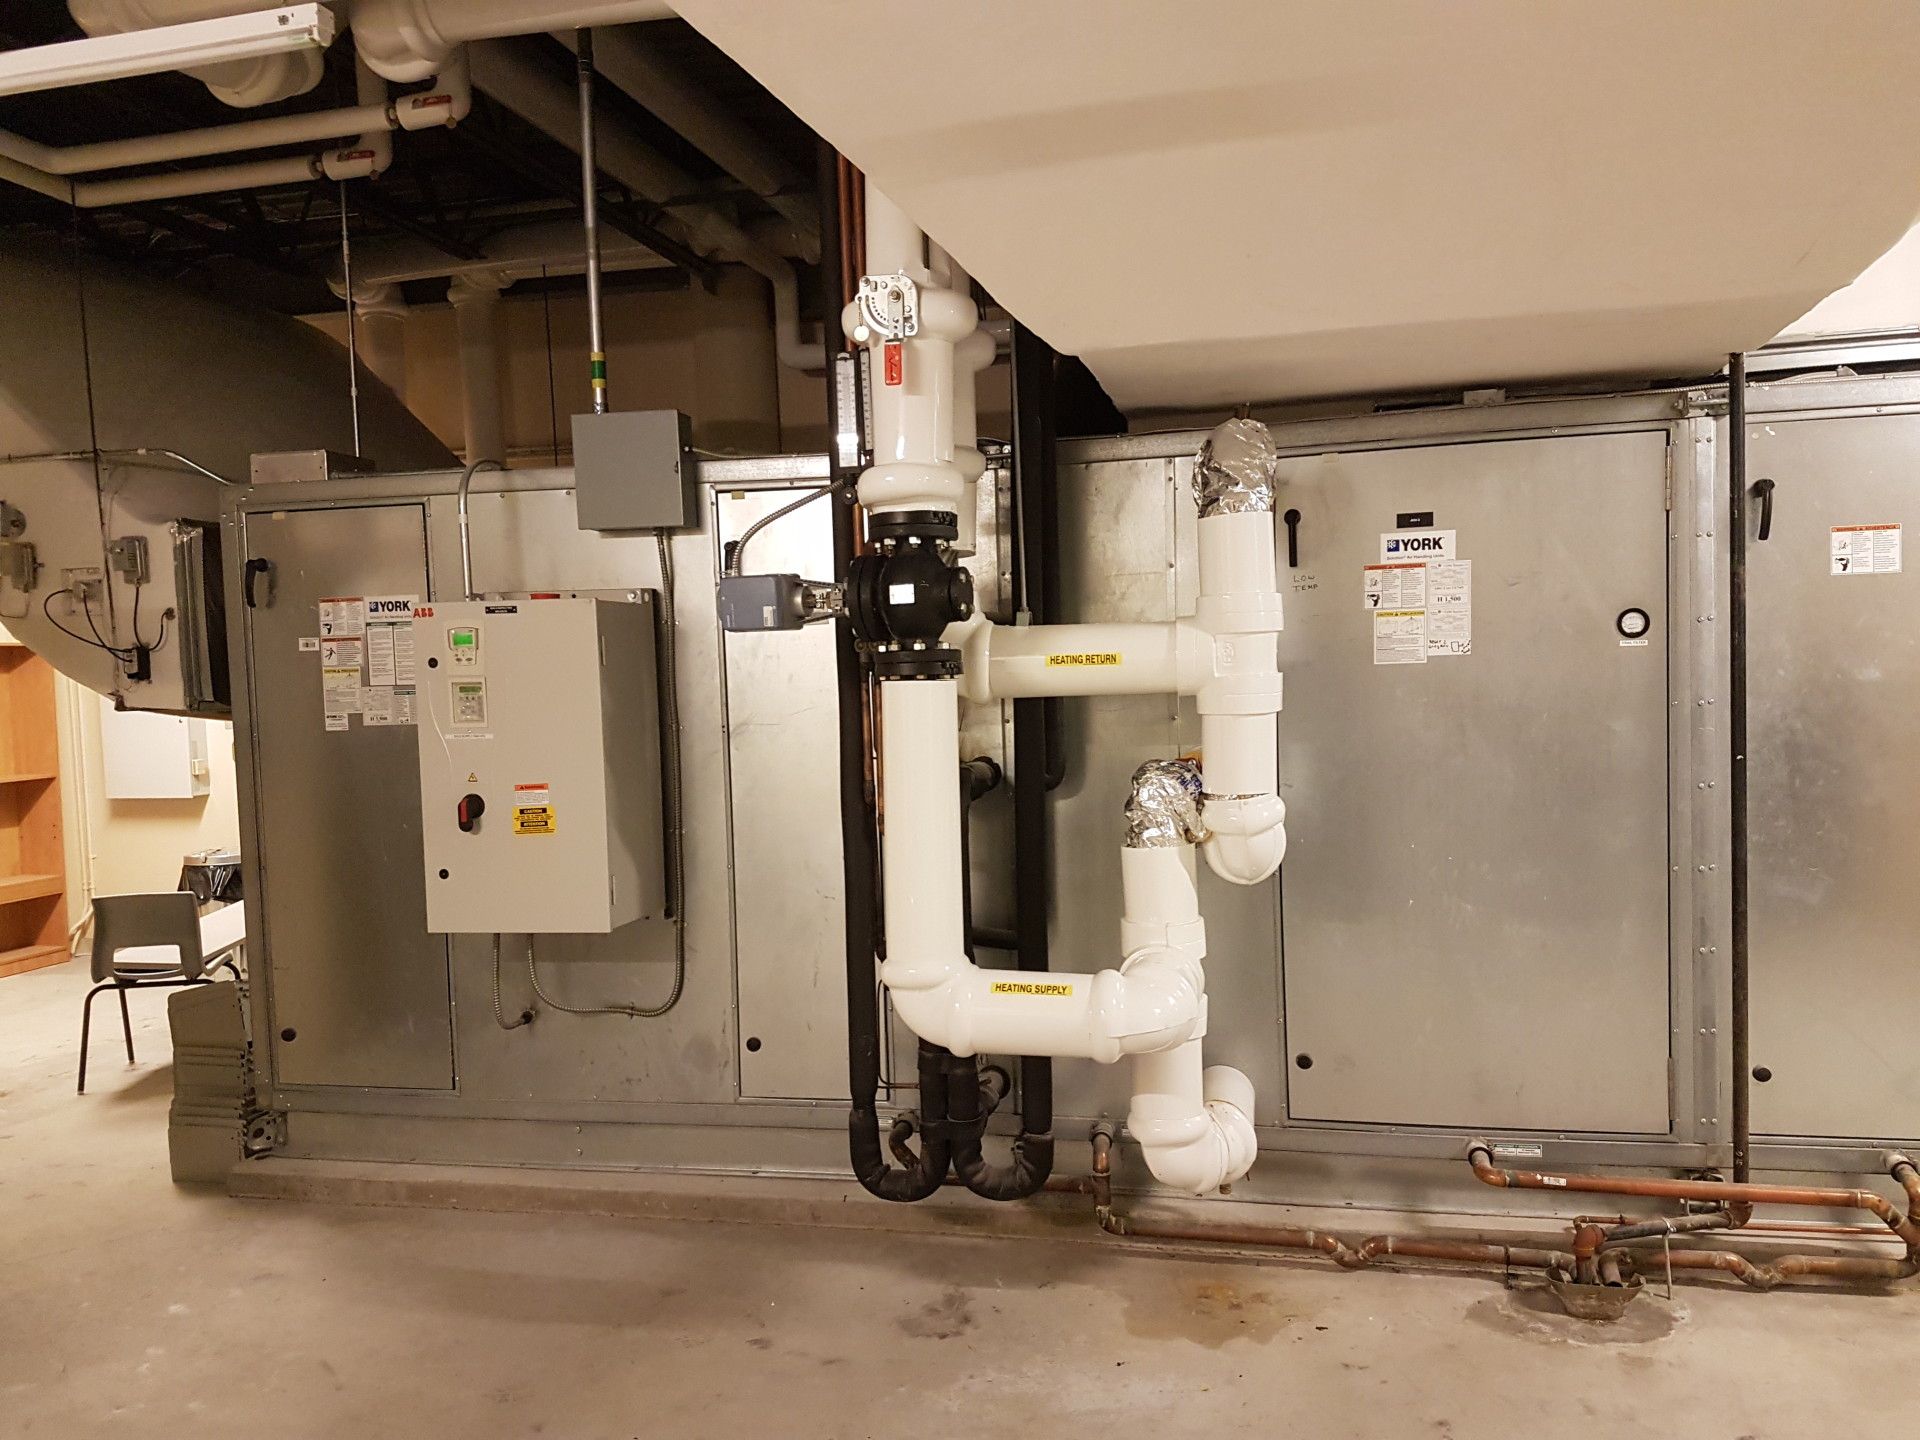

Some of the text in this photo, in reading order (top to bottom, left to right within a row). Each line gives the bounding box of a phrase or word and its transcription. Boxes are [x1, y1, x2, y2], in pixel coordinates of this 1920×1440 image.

[1401, 537, 1443, 551] YORK
[379, 600, 411, 612] YORK
[413, 607, 434, 618] ABB
[1050, 654, 1117, 665] HEATING RETURN
[995, 983, 1068, 994] HEATING SUPPLY
